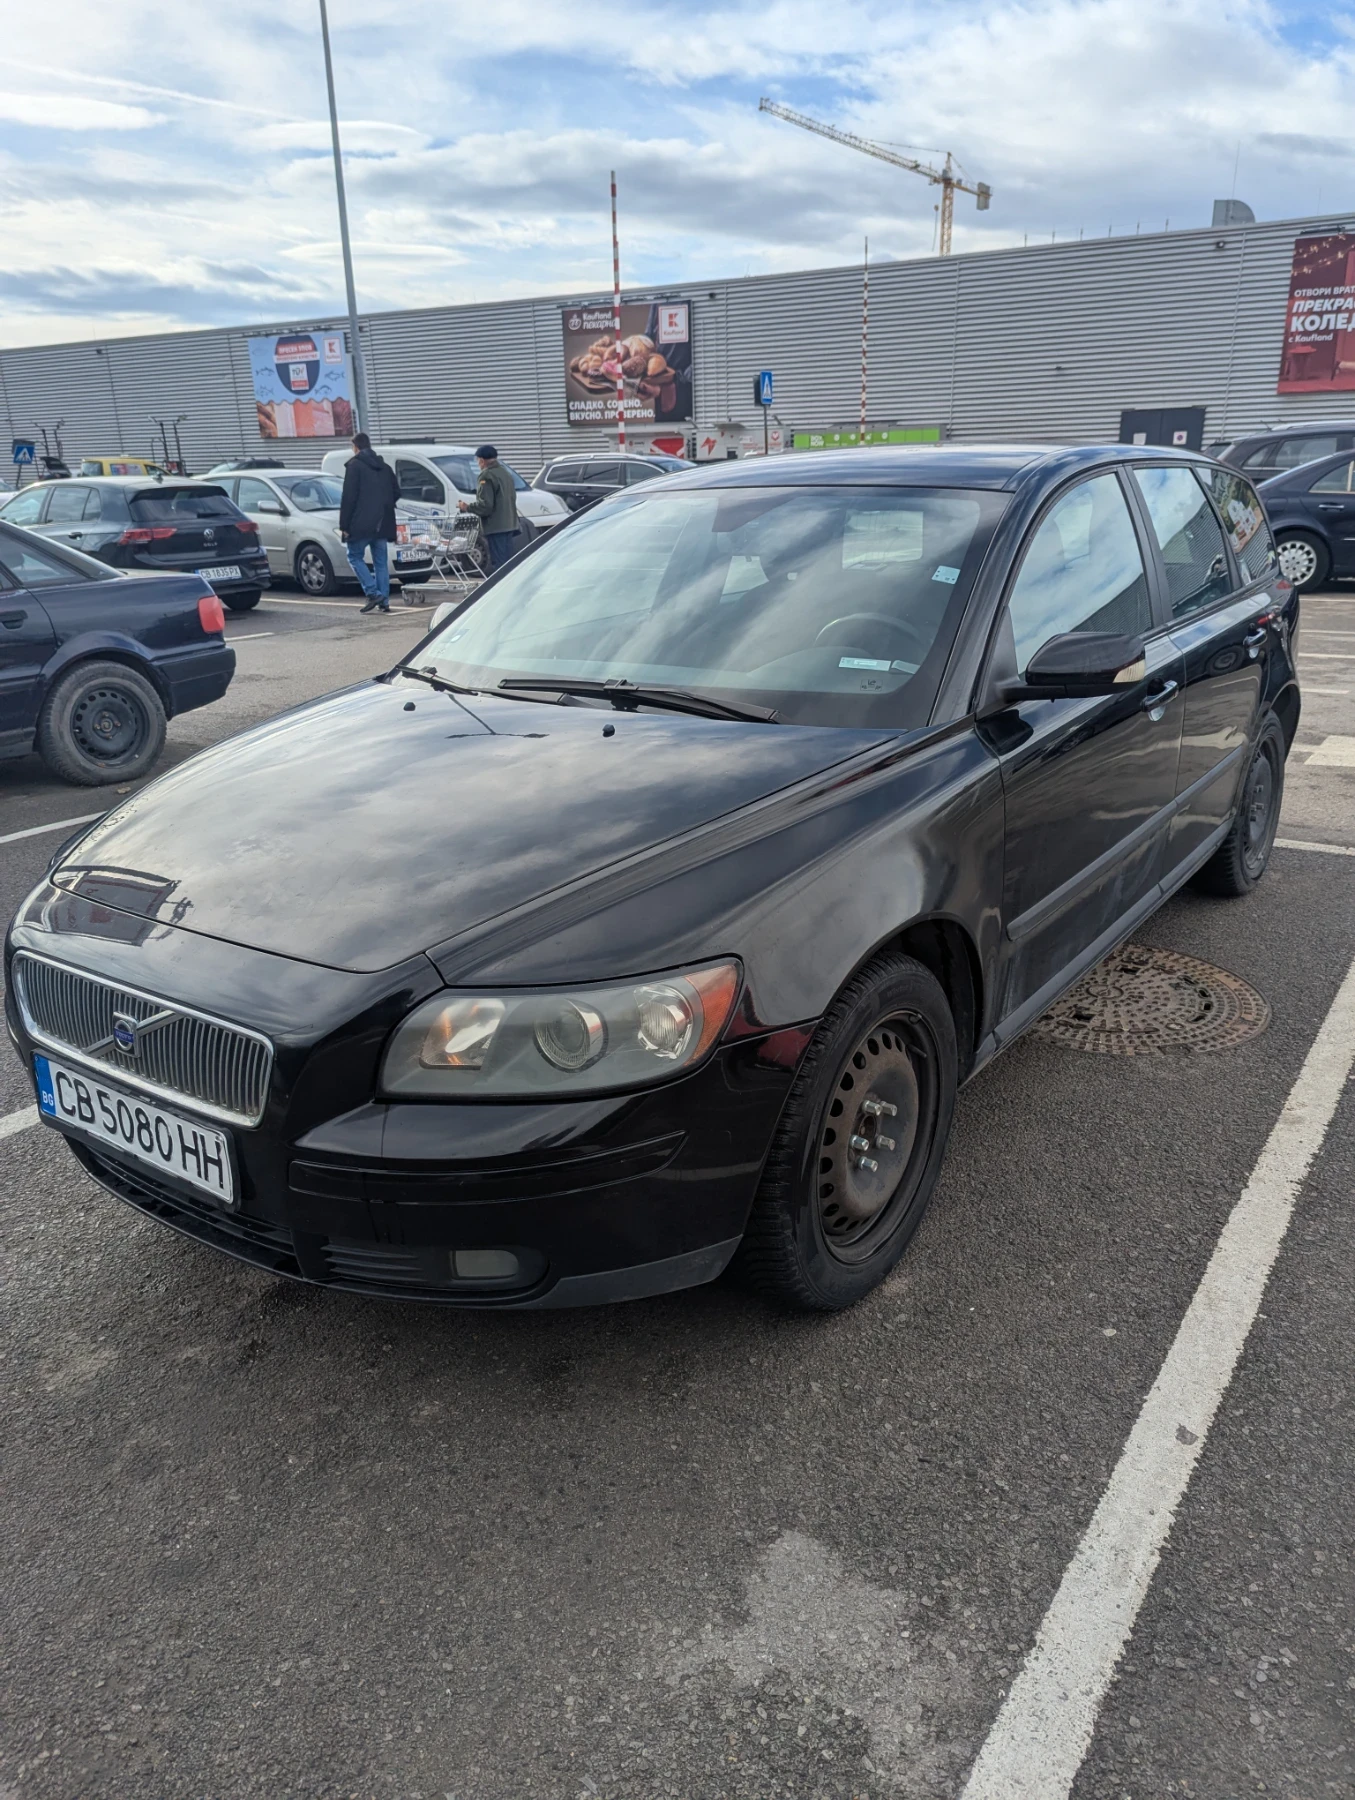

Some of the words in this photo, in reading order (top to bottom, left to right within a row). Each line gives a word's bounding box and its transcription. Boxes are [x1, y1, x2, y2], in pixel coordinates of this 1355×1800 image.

[1294, 287, 1331, 297] ОТВОРИ
[1292, 298, 1355, 313] ПРЕКРА
[582, 311, 612, 321] Kaufland
[1295, 333, 1333, 343] Kaufland
[569, 401, 605, 411] СЛАДКО.
[607, 399, 643, 409] СОЕНО.
[569, 411, 604, 420] ВКУСНО.
[42, 1090, 54, 1107] BG
